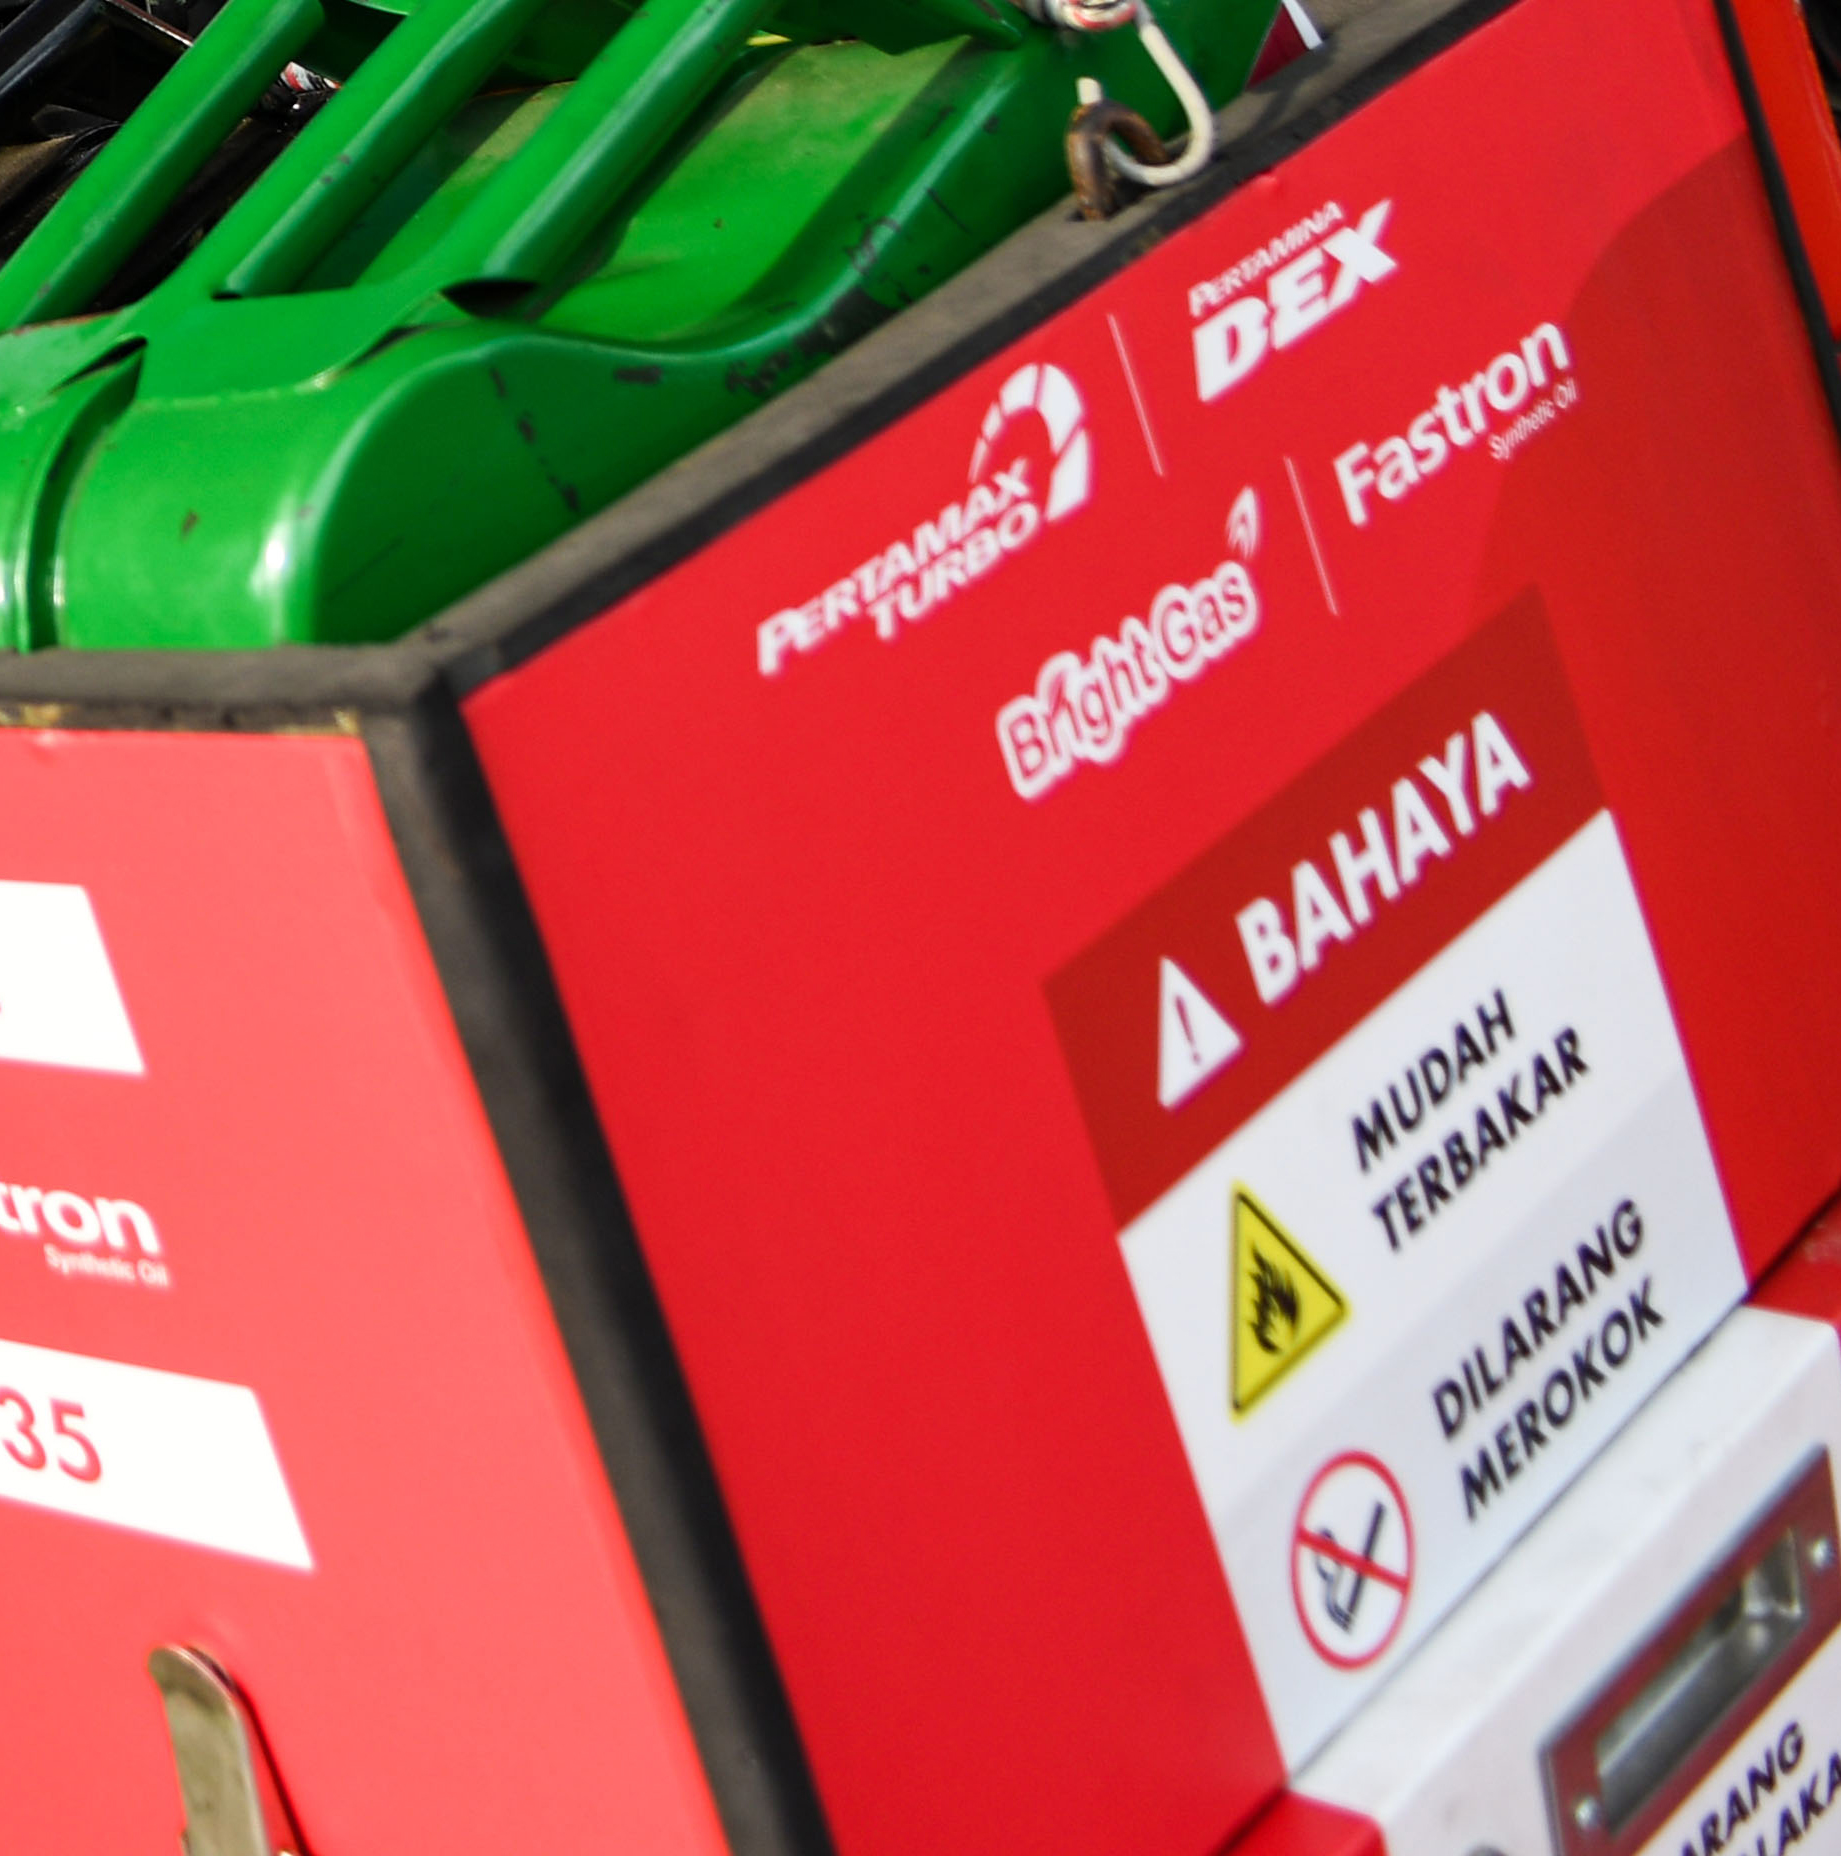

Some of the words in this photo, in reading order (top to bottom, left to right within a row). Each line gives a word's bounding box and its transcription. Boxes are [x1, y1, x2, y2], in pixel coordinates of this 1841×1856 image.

[1187, 198, 1346, 319] PERTAMINA
[1191, 196, 1400, 404] DEX
[1332, 320, 1571, 528] Fastron
[1488, 396, 1557, 462] Synthetic
[1554, 376, 1580, 411] Oil
[756, 457, 1033, 677] PERTAMAX
[867, 500, 1040, 643] TURBO
[1233, 710, 1533, 1008] BAHAYA
[1348, 985, 1519, 1174] MUDAH
[1371, 1024, 1590, 1253] TERBAKAR
[43, 1244, 132, 1286] Synthetic
[135, 1259, 171, 1291] Oil
[1432, 1197, 1647, 1442] DILARANG
[1458, 1274, 1667, 1524] MEROKOK
